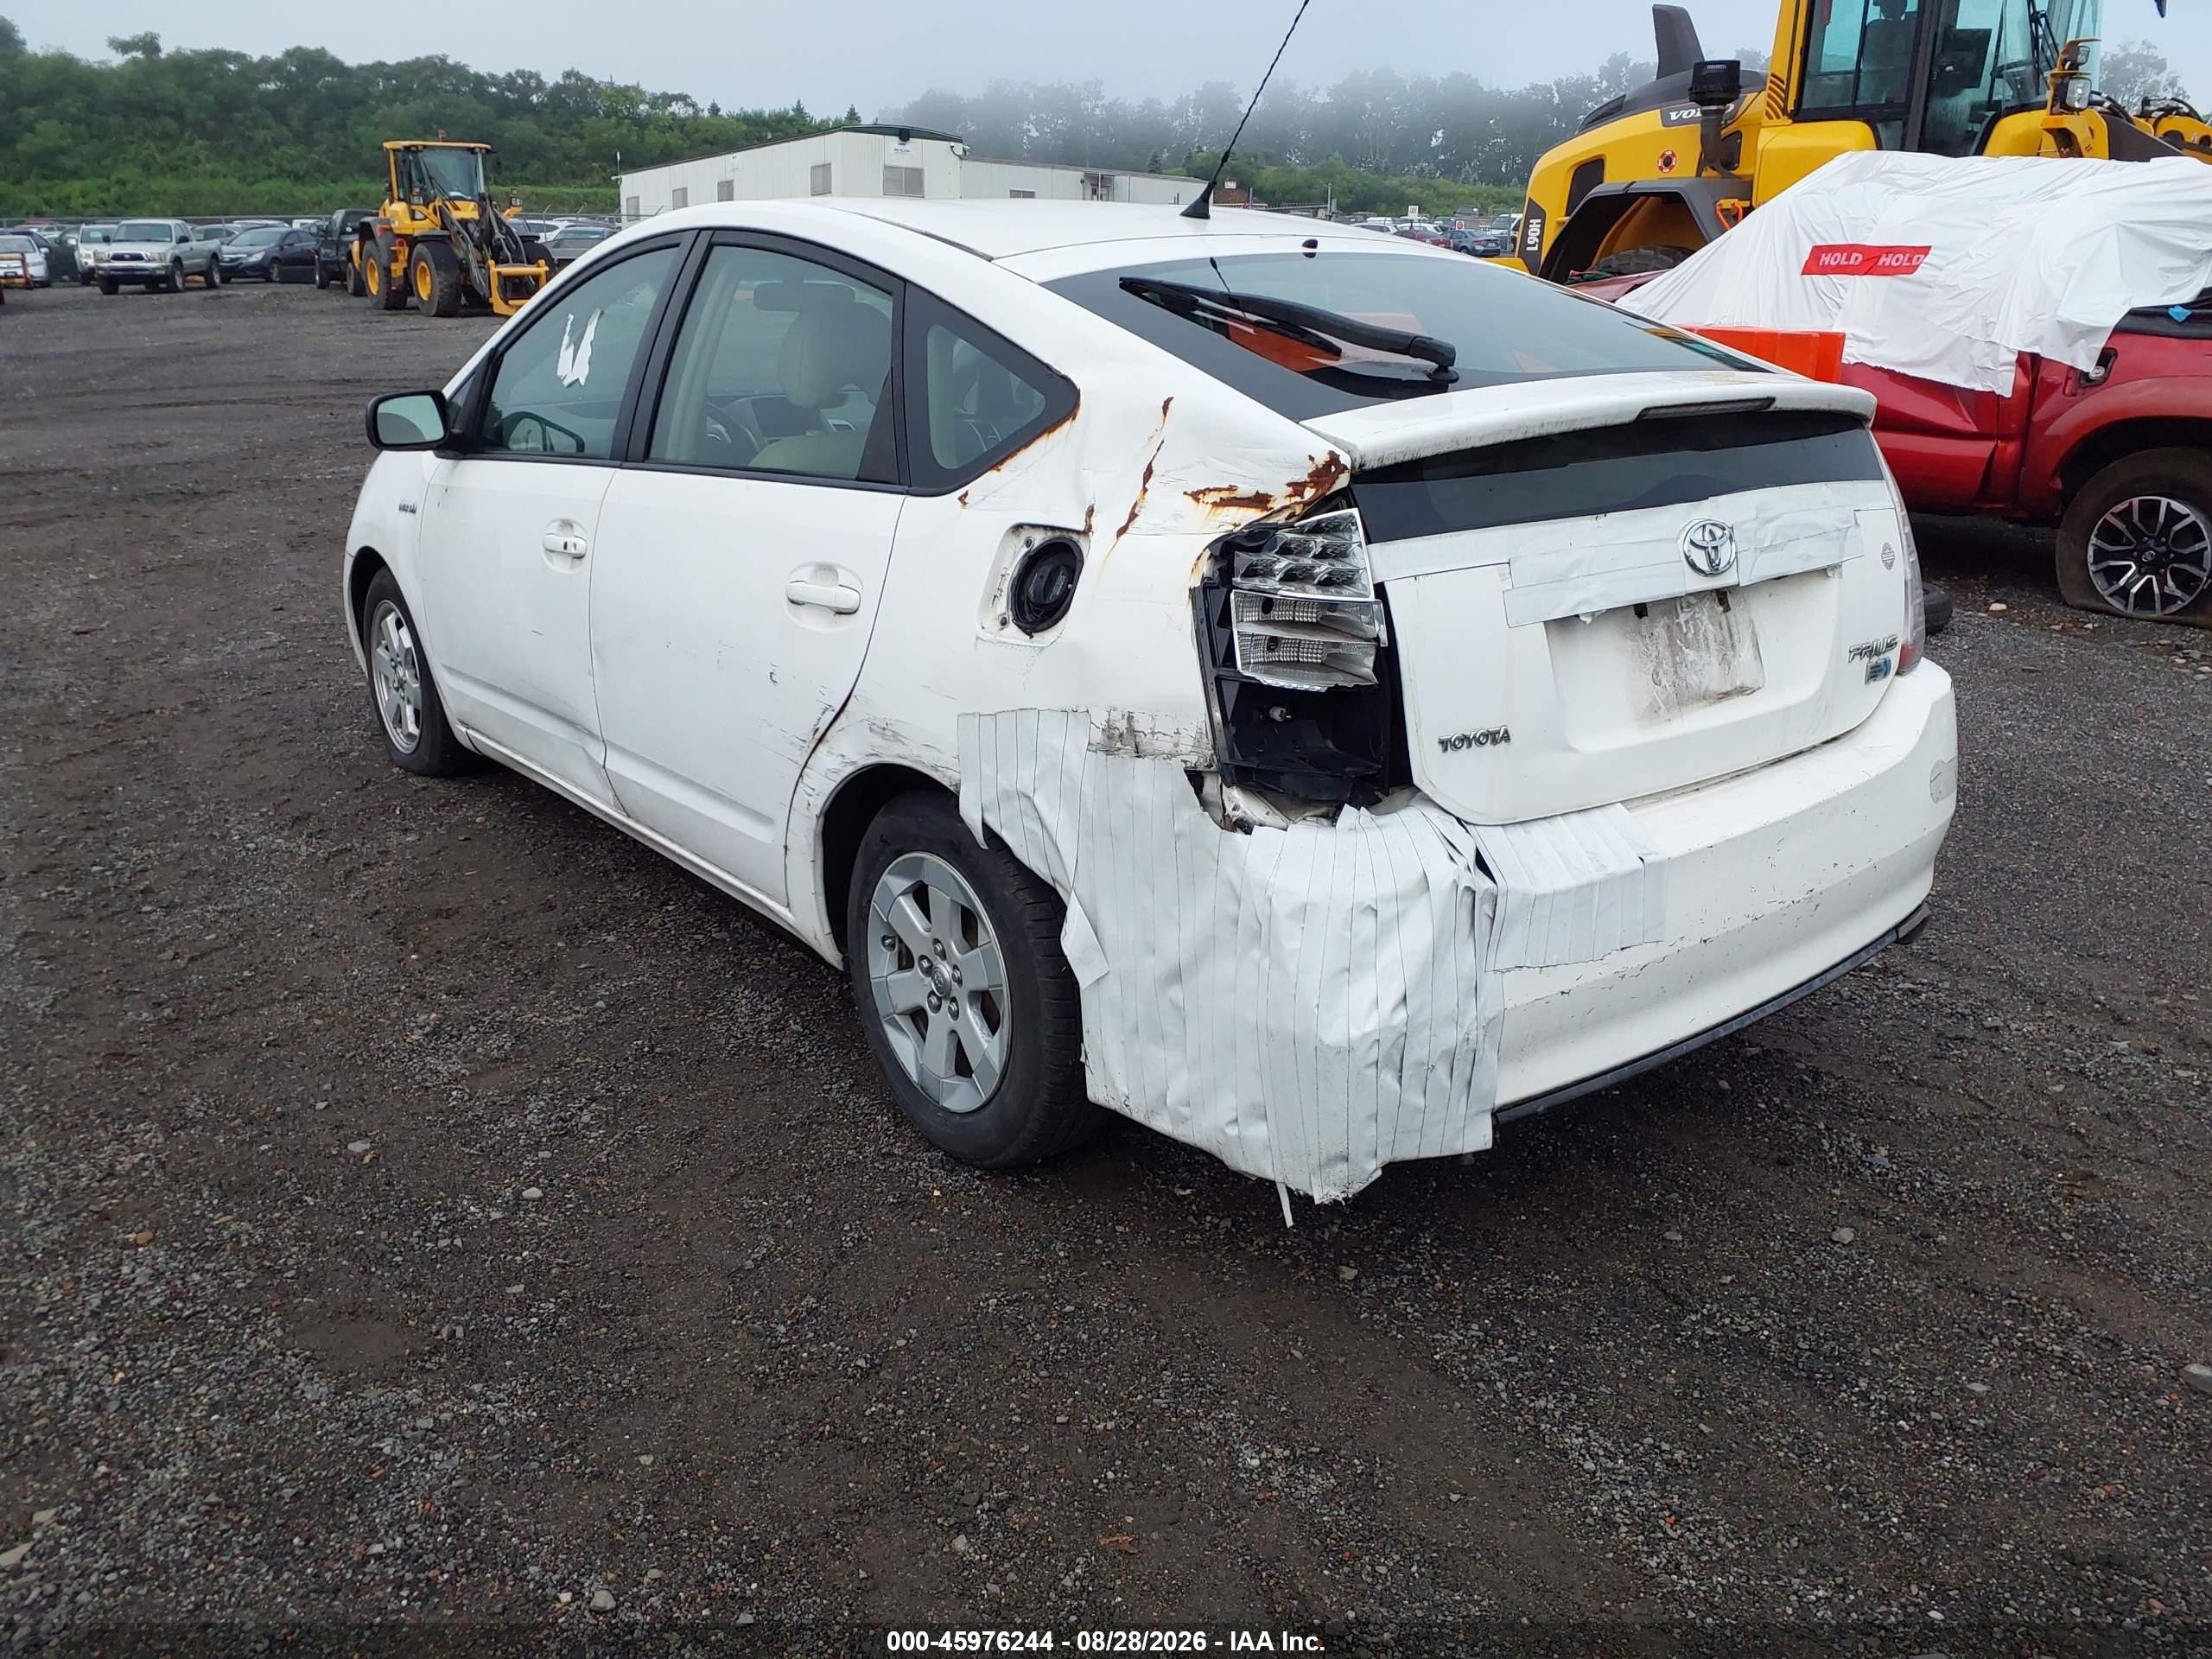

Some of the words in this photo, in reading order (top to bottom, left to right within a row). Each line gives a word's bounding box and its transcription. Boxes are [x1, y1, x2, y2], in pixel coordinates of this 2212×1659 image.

[1669, 103, 1735, 121] VOLO
[1526, 219, 1541, 251] L90H
[1819, 252, 1863, 266] HOLD
[1878, 253, 1925, 266] HOLD
[1848, 635, 1898, 663] PRIUS
[1439, 725, 1510, 753] TOYOTA
